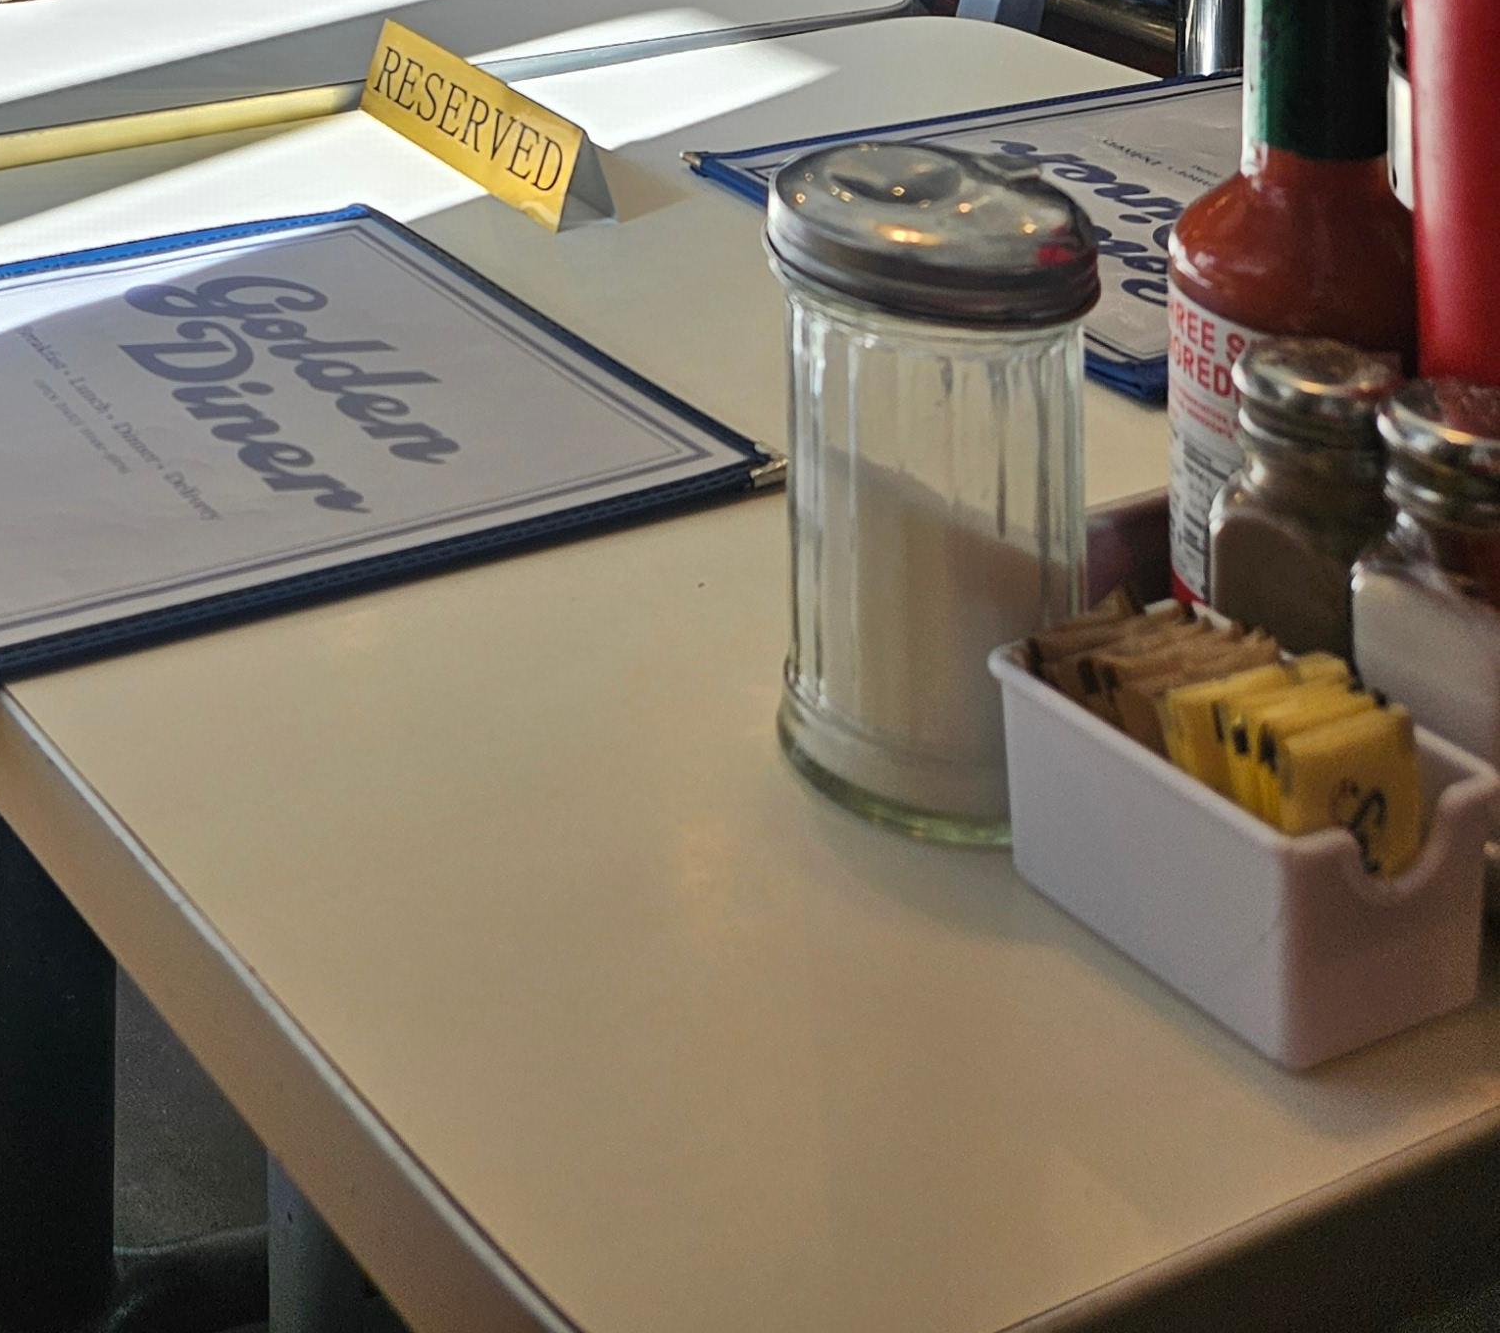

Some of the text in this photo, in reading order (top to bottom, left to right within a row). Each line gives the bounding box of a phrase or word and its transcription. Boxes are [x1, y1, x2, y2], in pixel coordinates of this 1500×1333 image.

[373, 46, 563, 192] RESERVED
[117, 320, 372, 513] Diner
[123, 276, 461, 464] Golden
